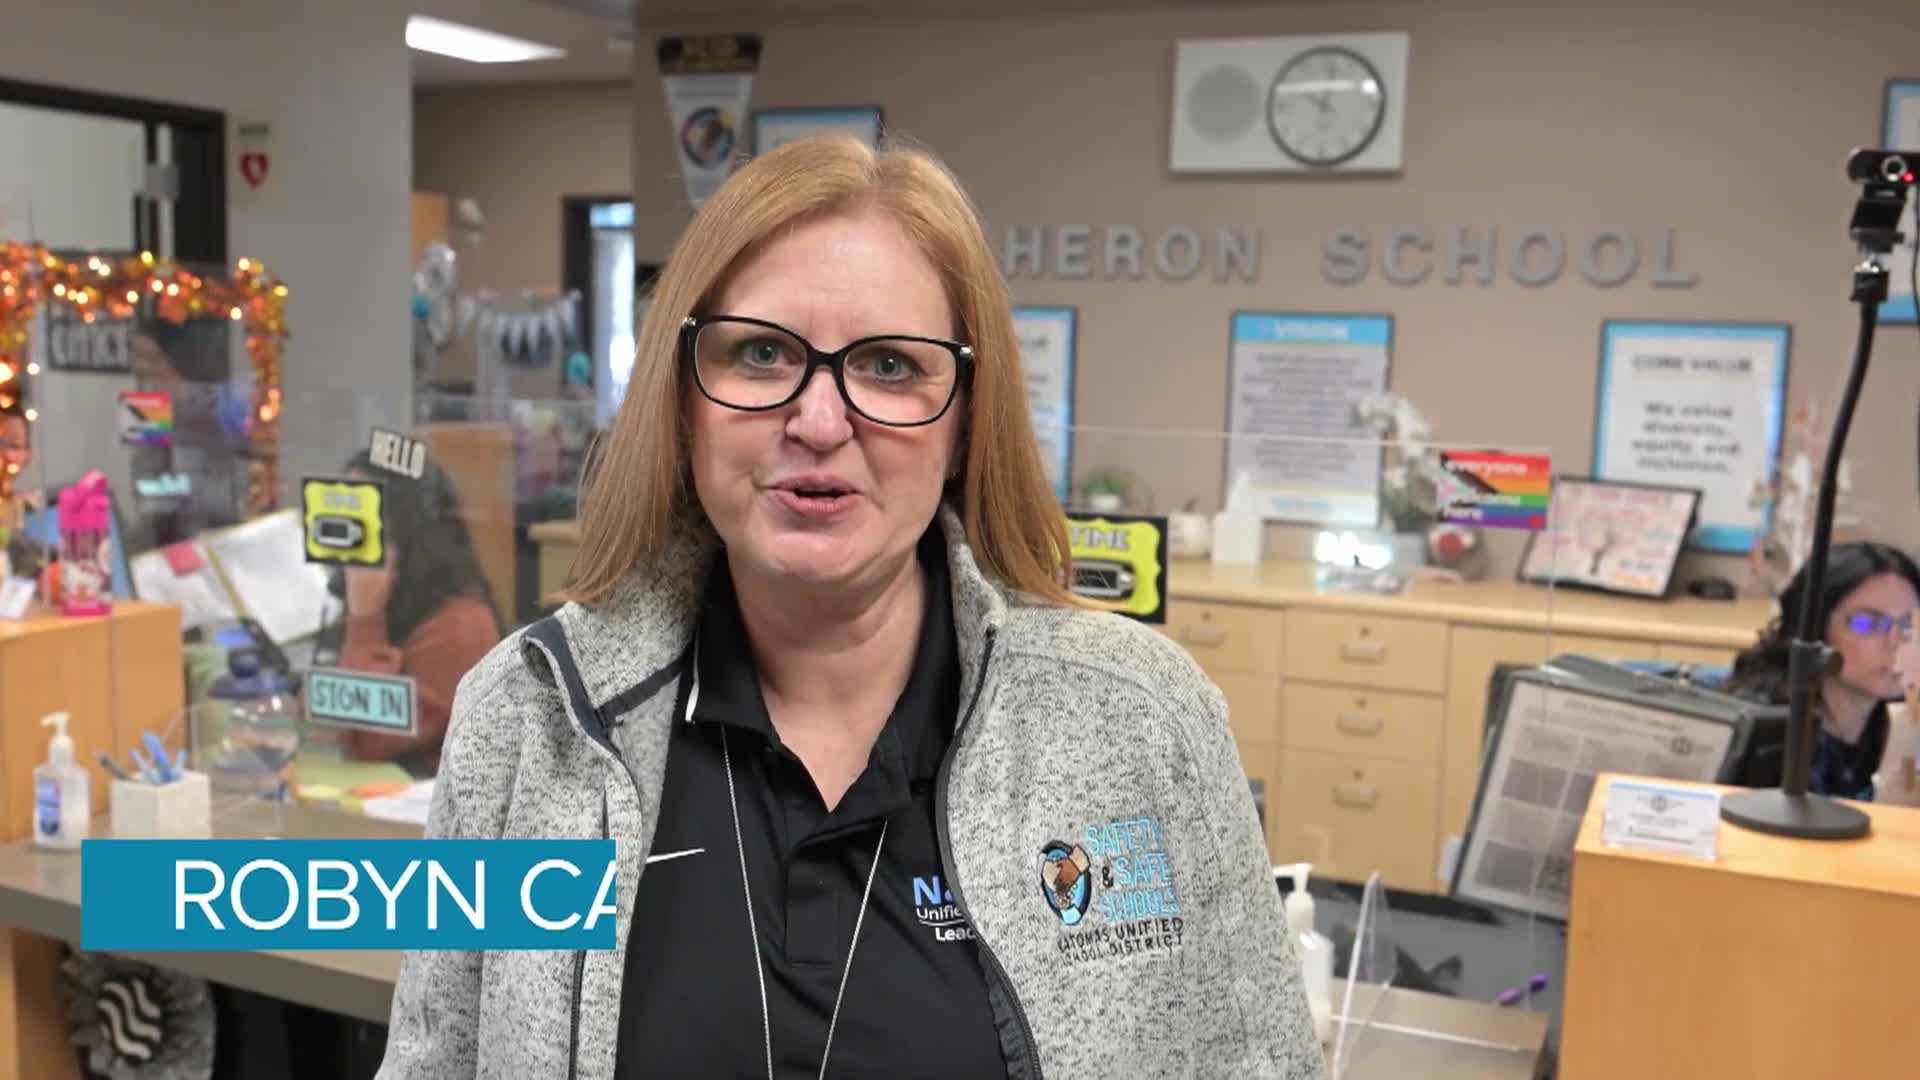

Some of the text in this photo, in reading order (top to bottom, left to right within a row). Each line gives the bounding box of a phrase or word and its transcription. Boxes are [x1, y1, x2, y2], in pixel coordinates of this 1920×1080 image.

[1005, 224, 1697, 288] HERON SCHOOL
[369, 429, 425, 479] HELLO
[1071, 526, 1131, 552] TIME
[315, 679, 403, 719] SIGN IN
[1086, 817, 1164, 856] SAFETY
[1101, 852, 1170, 888] & SAFE
[1101, 886, 1183, 923] SCHOOLS
[1109, 933, 1183, 957] DISTRICT
[1115, 917, 1184, 940] UNIFIED
